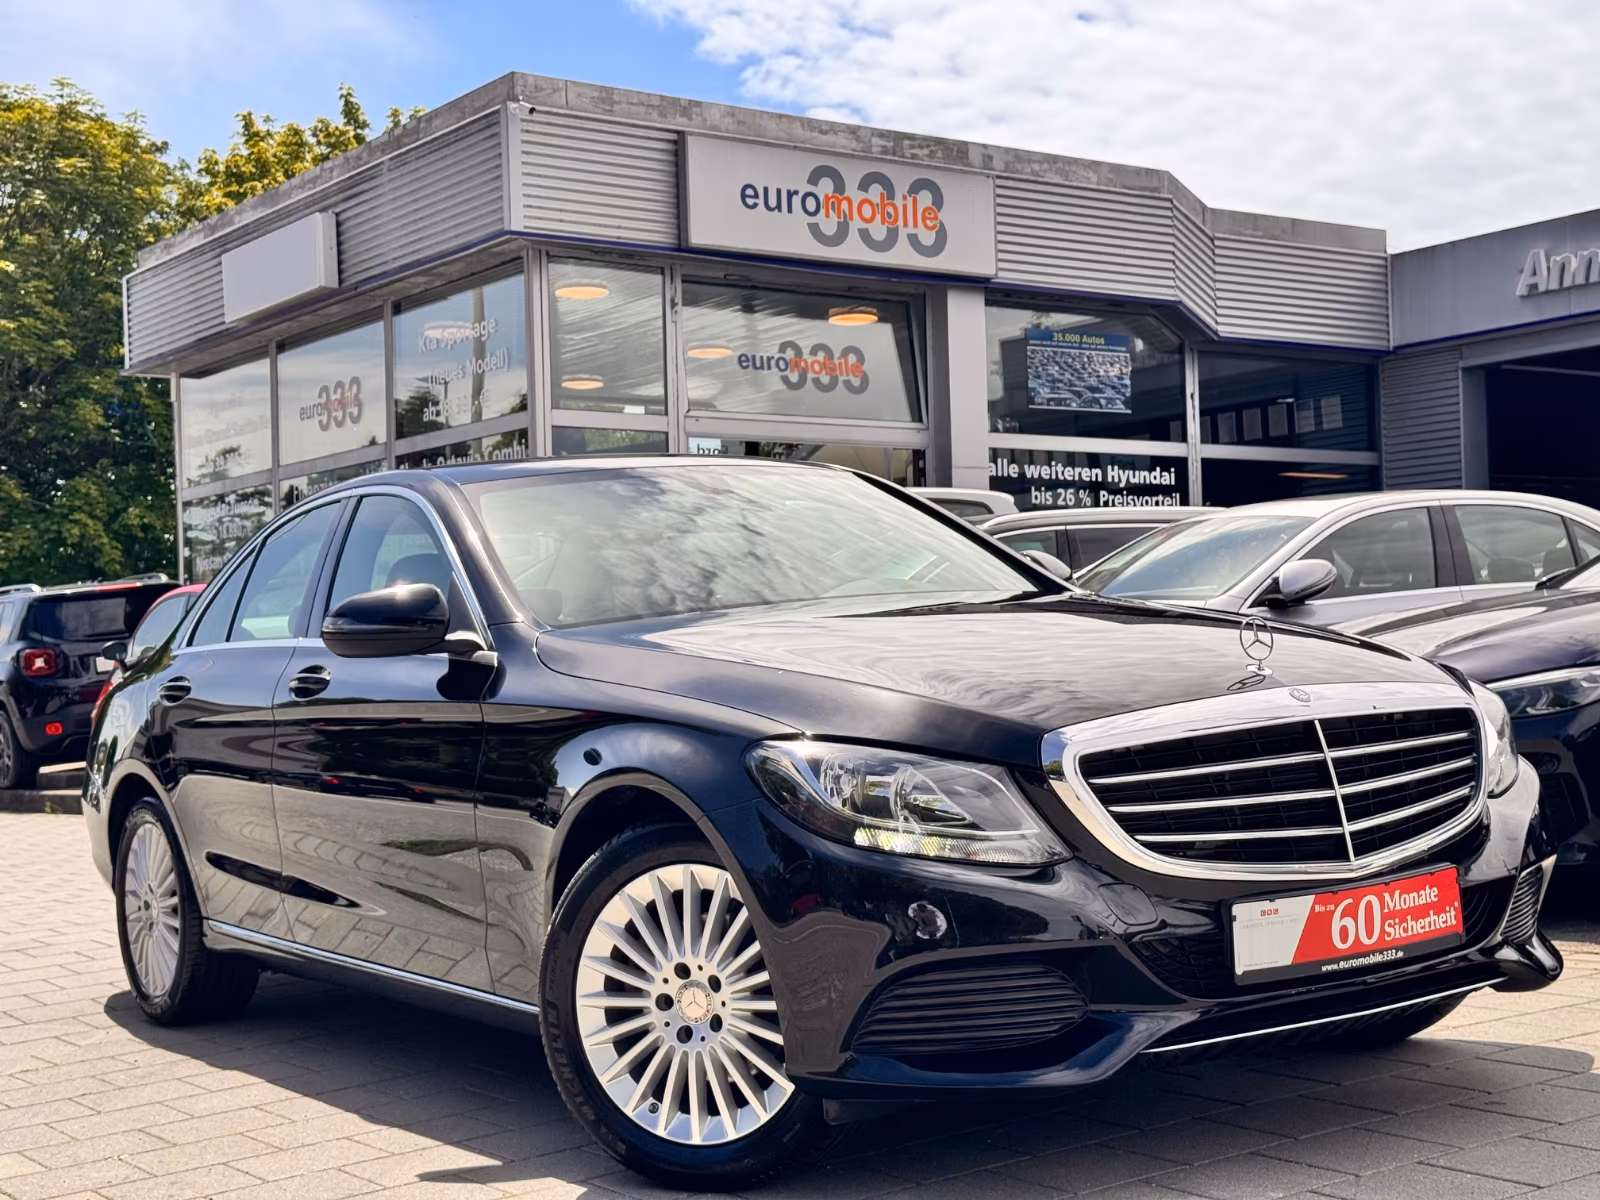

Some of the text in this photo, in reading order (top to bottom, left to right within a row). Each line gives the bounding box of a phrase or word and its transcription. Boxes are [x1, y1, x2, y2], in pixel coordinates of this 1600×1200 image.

[739, 182, 940, 232] euromobile
[1051, 332, 1105, 344] 35.000 Autos
[737, 352, 864, 378] euromobile
[988, 458, 1018, 478] alle
[1023, 461, 1102, 482] weiteren
[1107, 464, 1176, 487] Hyundai
[1031, 486, 1180, 508] bis 26 % Preisvorteil
[1314, 903, 1325, 913] Bis
[1383, 884, 1439, 913] Monate
[1331, 894, 1382, 950] 60
[1321, 949, 1404, 972] www.euromobile333.de
